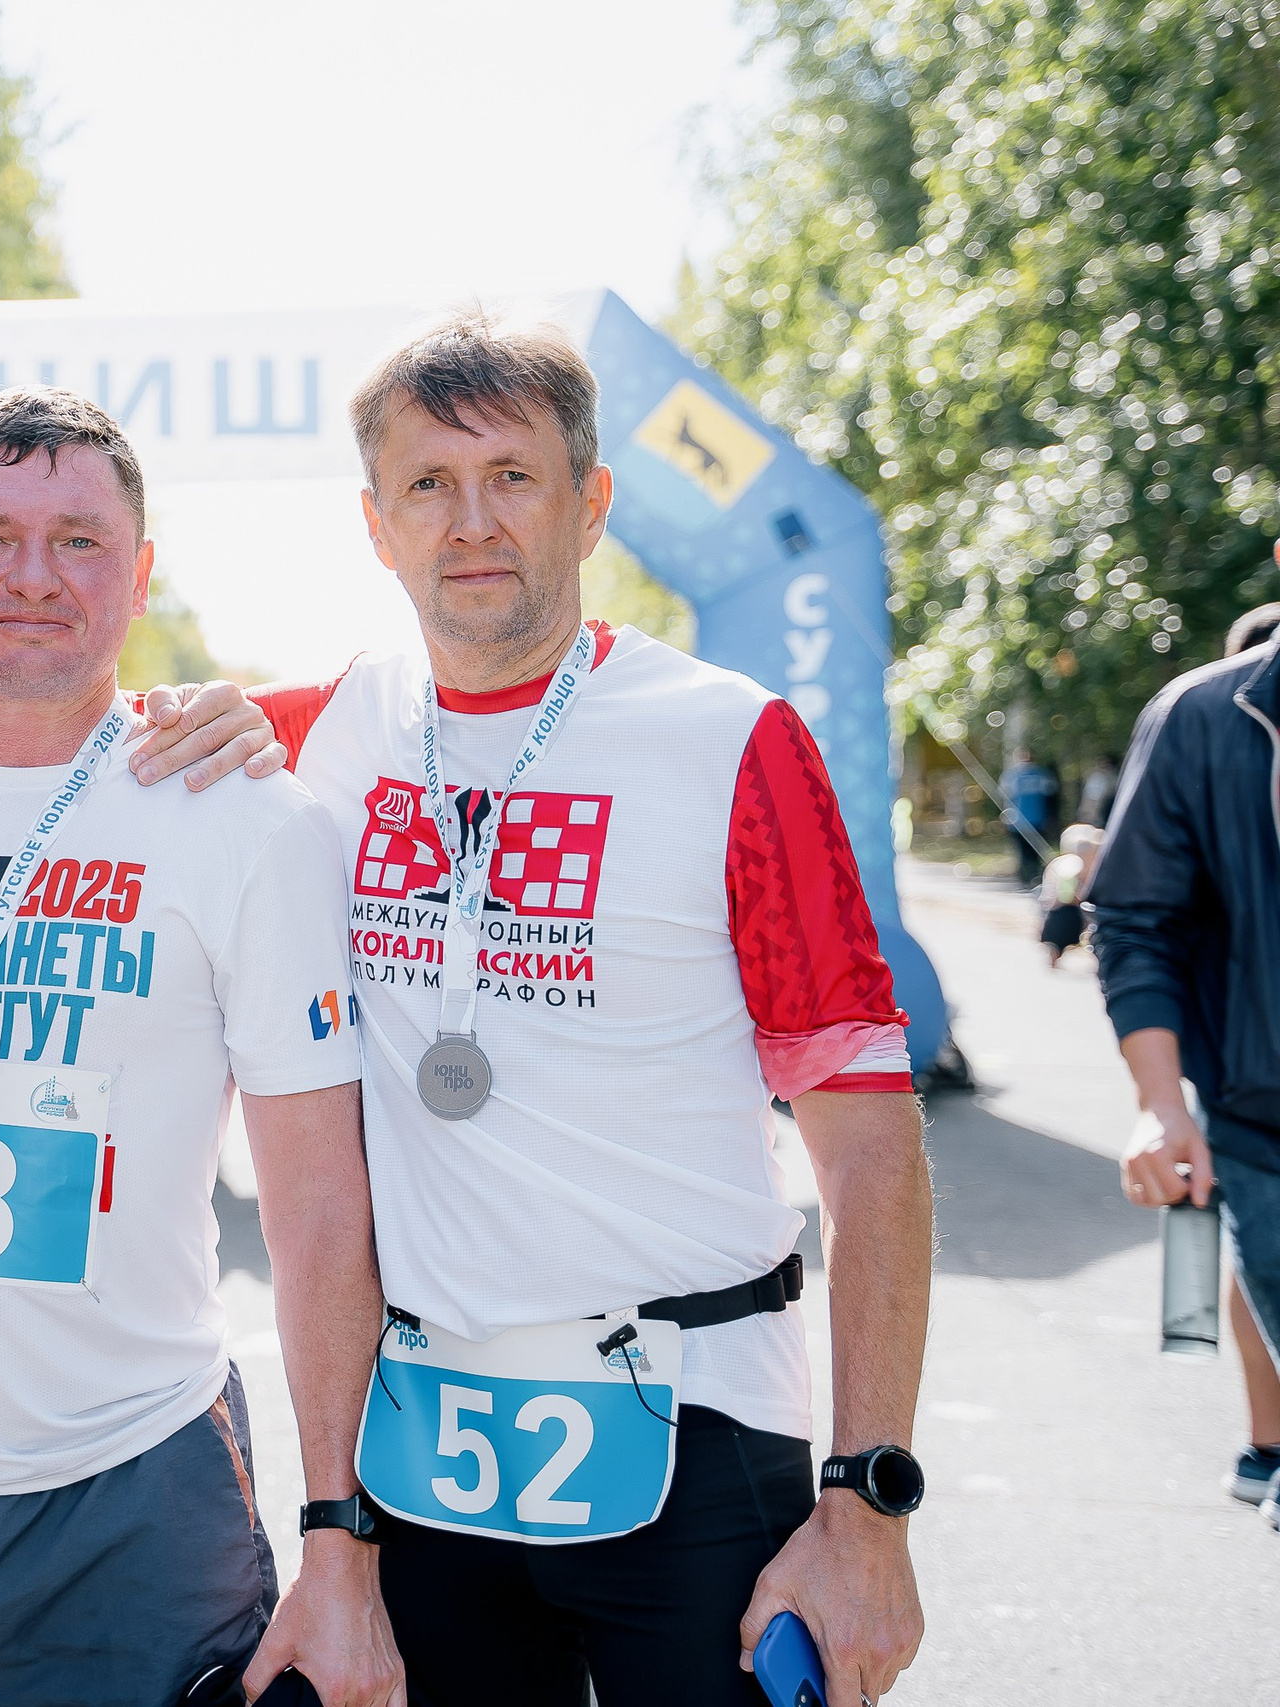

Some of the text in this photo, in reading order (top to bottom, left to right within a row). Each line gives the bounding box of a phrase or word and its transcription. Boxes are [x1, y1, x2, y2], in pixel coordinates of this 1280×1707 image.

[532, 673, 577, 746] КОЛЬЦО
[576, 626, 591, 659] 202
[36, 768, 90, 835] КОЛЬЦО
[93, 712, 125, 753] 2025
[424, 725, 440, 800] КОЛЬЦО
[351, 900, 594, 946] МЕЖДУНОДНЫЙ
[354, 961, 596, 1008] ПОЛУМРАФОН
[431, 1382, 595, 1525] 52
